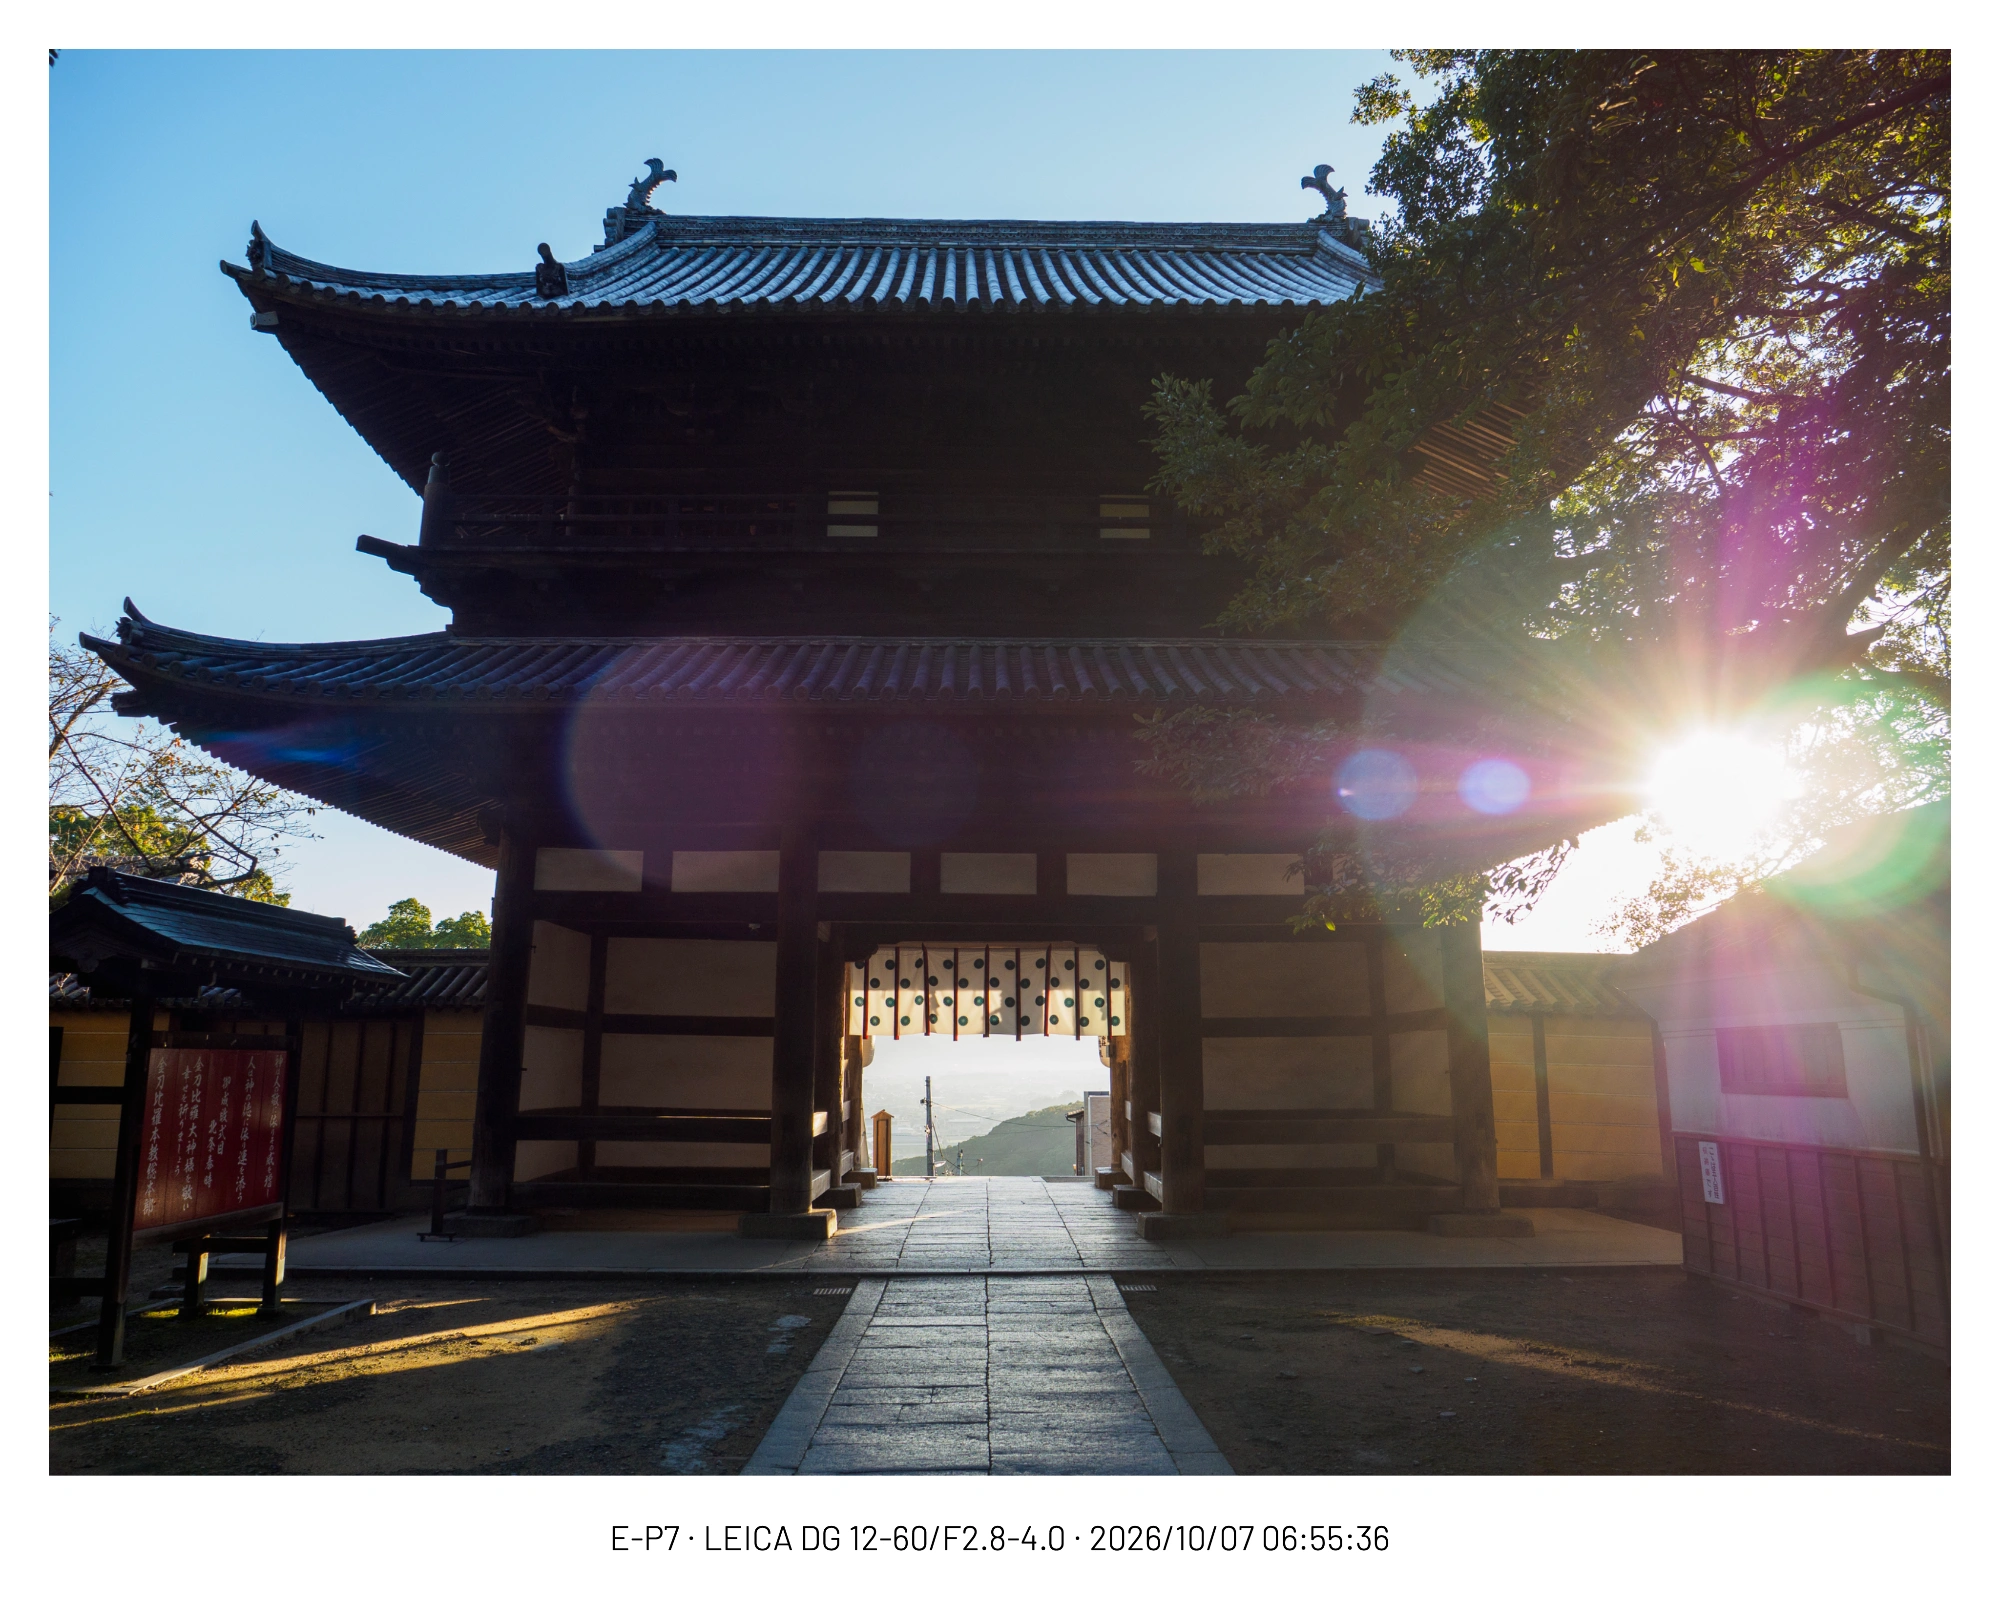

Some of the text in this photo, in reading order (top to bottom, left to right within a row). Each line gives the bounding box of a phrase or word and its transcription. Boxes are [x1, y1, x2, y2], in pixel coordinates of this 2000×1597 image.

[174, 1064, 192, 1178] 幸せを祈りましょう
